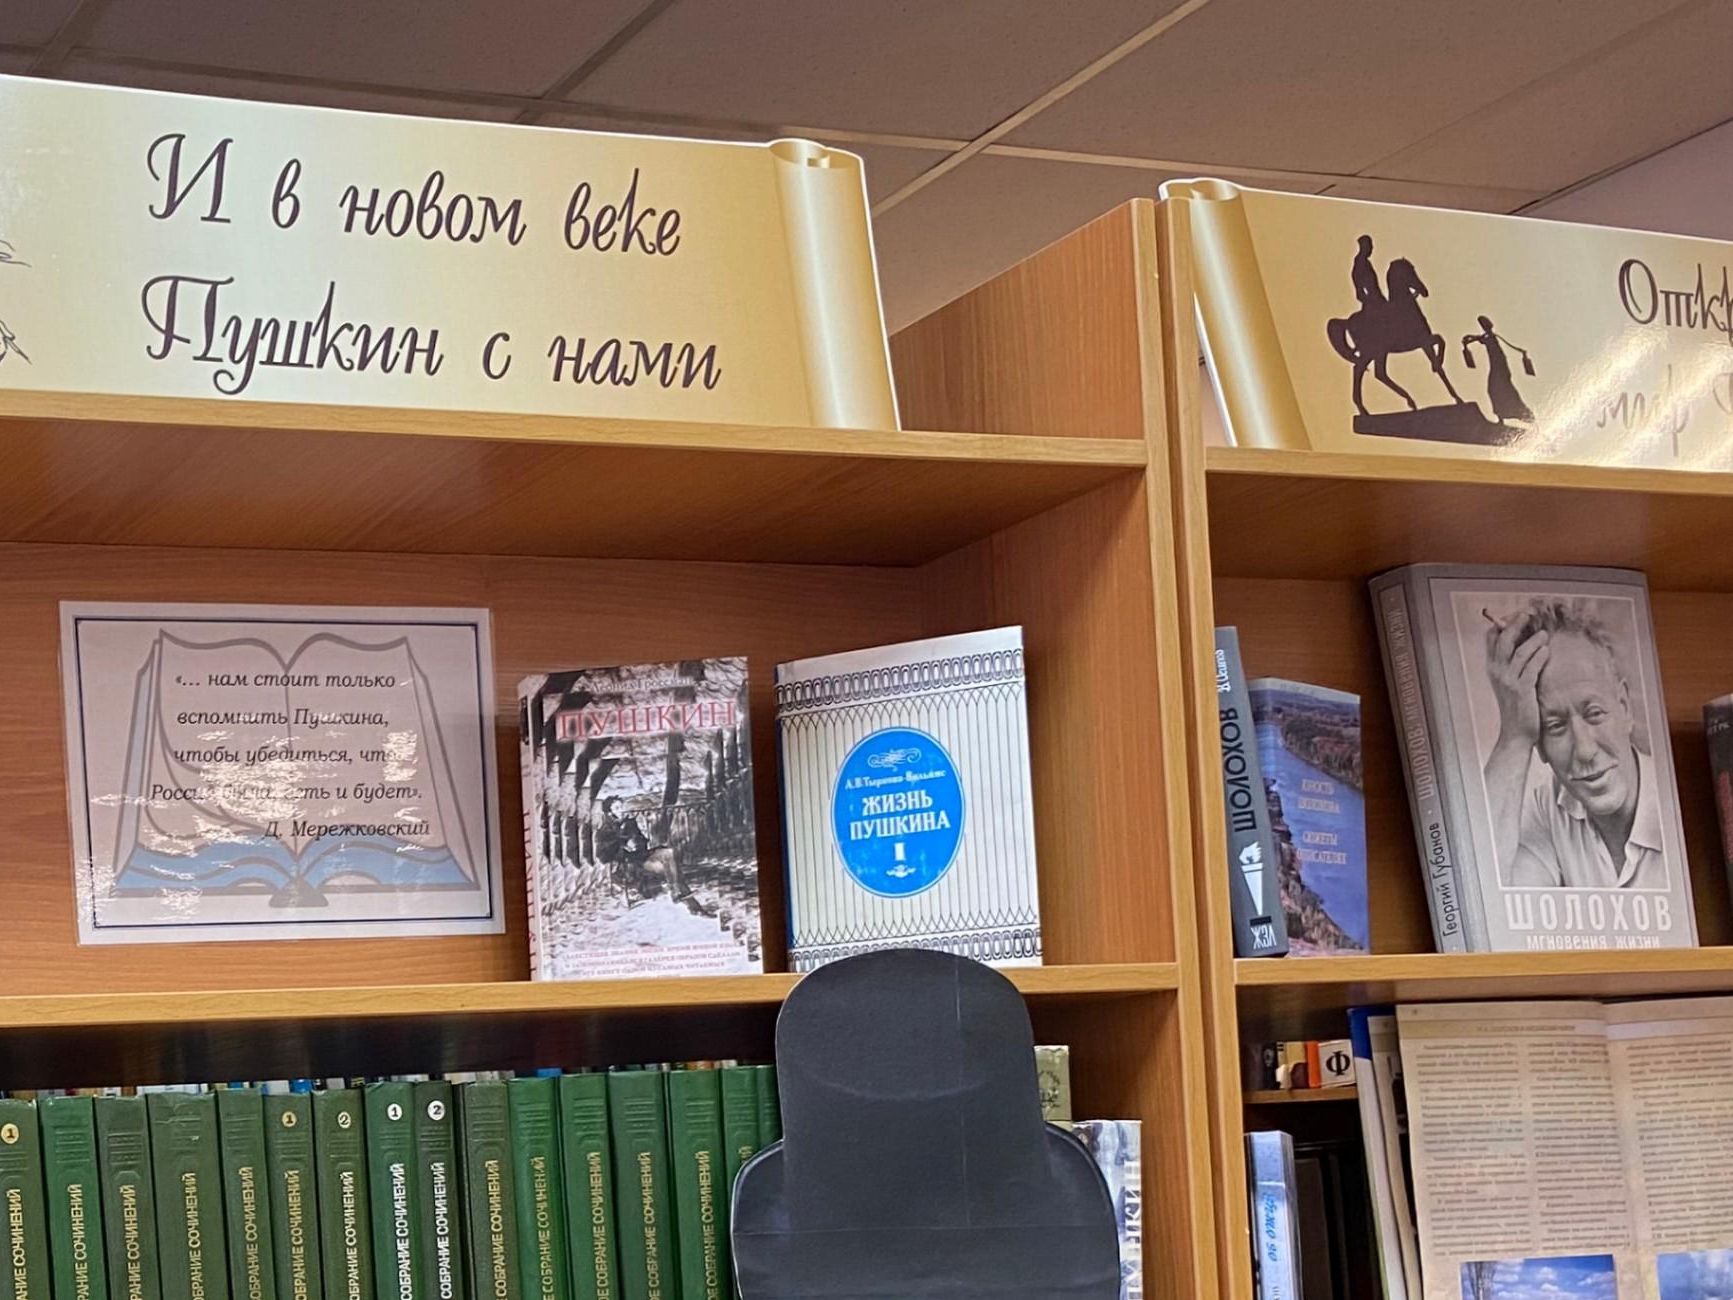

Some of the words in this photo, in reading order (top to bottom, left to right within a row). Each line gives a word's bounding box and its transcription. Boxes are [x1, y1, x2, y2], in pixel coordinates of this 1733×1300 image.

[146, 132, 234, 224] И
[271, 159, 302, 229] в
[338, 170, 527, 247] новом
[564, 167, 681, 257] веке
[140, 275, 445, 395] Пушкин
[482, 331, 512, 380] с
[547, 338, 723, 390] нами
[208, 675, 248, 687] нам
[253, 675, 320, 687] стоит
[325, 675, 396, 688] только
[176, 711, 288, 725] вспомнить
[293, 708, 389, 729] Пушкина,
[559, 699, 736, 741] ПУШКИН
[174, 746, 240, 763] чтобы
[245, 746, 353, 766] убедиться,
[336, 788, 348, 799] и
[862, 789, 933, 816] ЖИЗНЬ
[264, 820, 282, 840] Д.
[291, 821, 430, 842] Мережковский
[850, 810, 951, 840] ПУШКИНА
[1429, 823, 1452, 879] Губанов
[1434, 881, 1459, 937] Георгий
[1505, 892, 1672, 931] ШОЛОХОВ
[1325, 1048, 1350, 1077] Ф
[390, 1163, 407, 1237] СОЧИНЕНИЙ
[396, 1238, 412, 1300] СОБРАНИЕ
